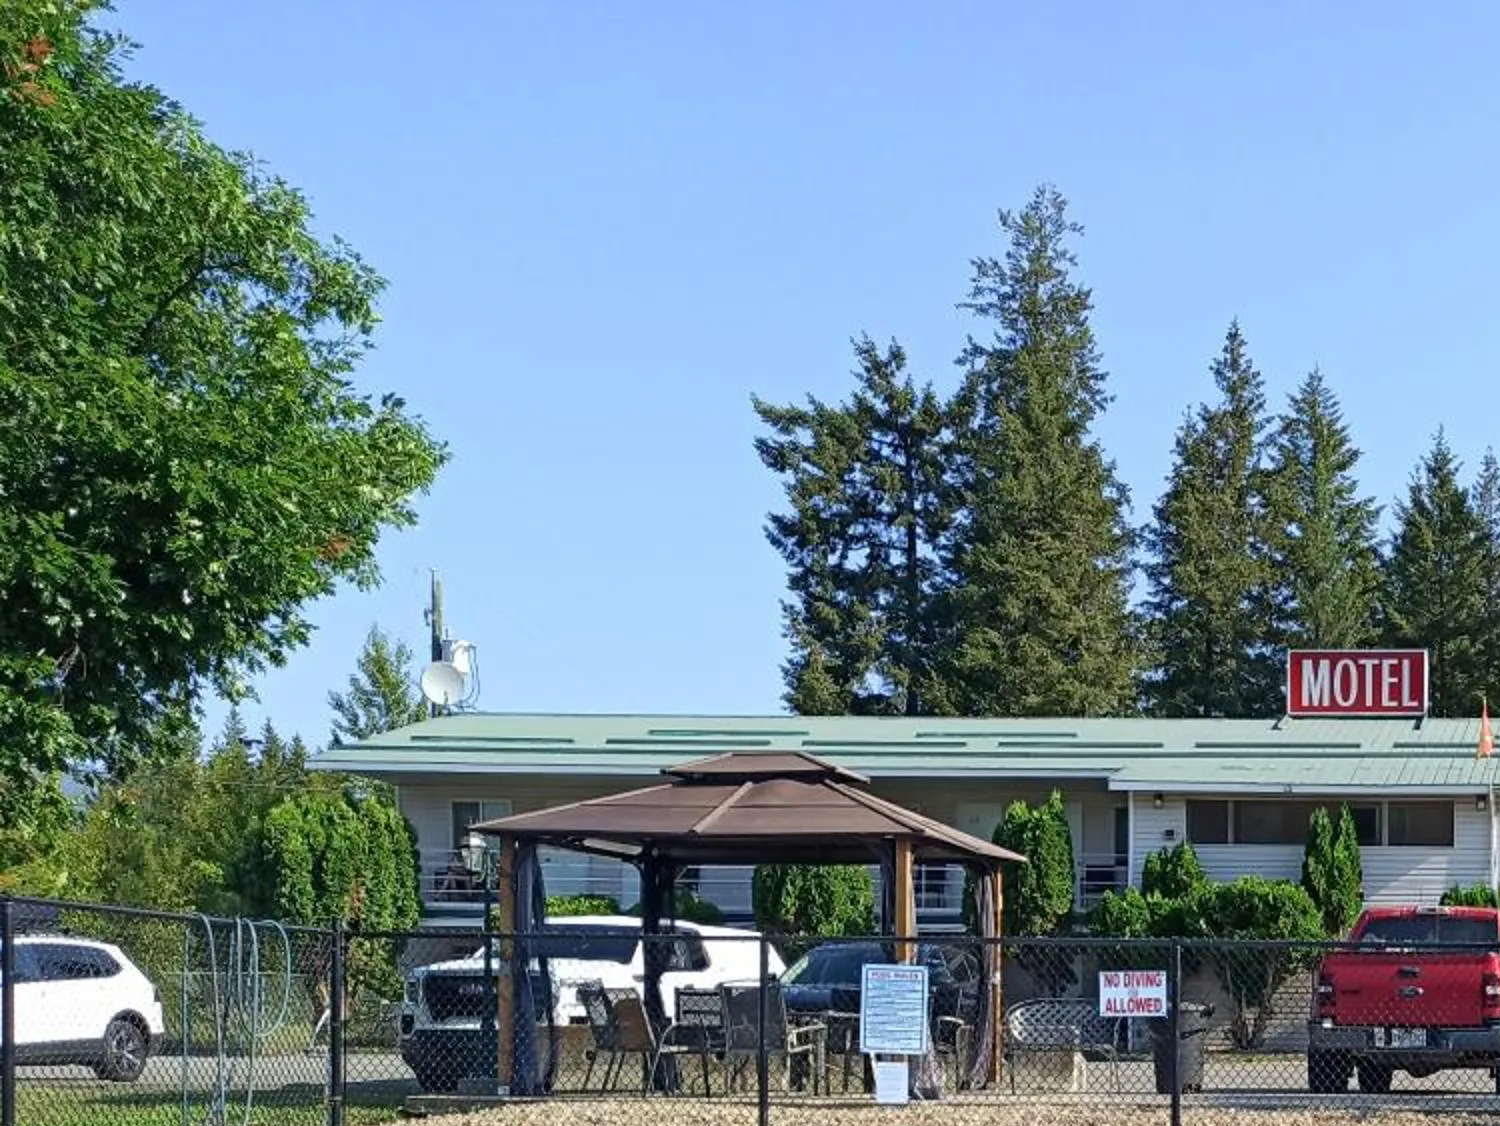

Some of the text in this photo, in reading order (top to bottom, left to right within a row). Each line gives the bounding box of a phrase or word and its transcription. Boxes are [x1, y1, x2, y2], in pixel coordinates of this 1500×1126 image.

[1301, 658, 1419, 707] MOTEL
[1103, 973, 1162, 988] NO DIVING
[1106, 997, 1162, 1013] ALLOWED
